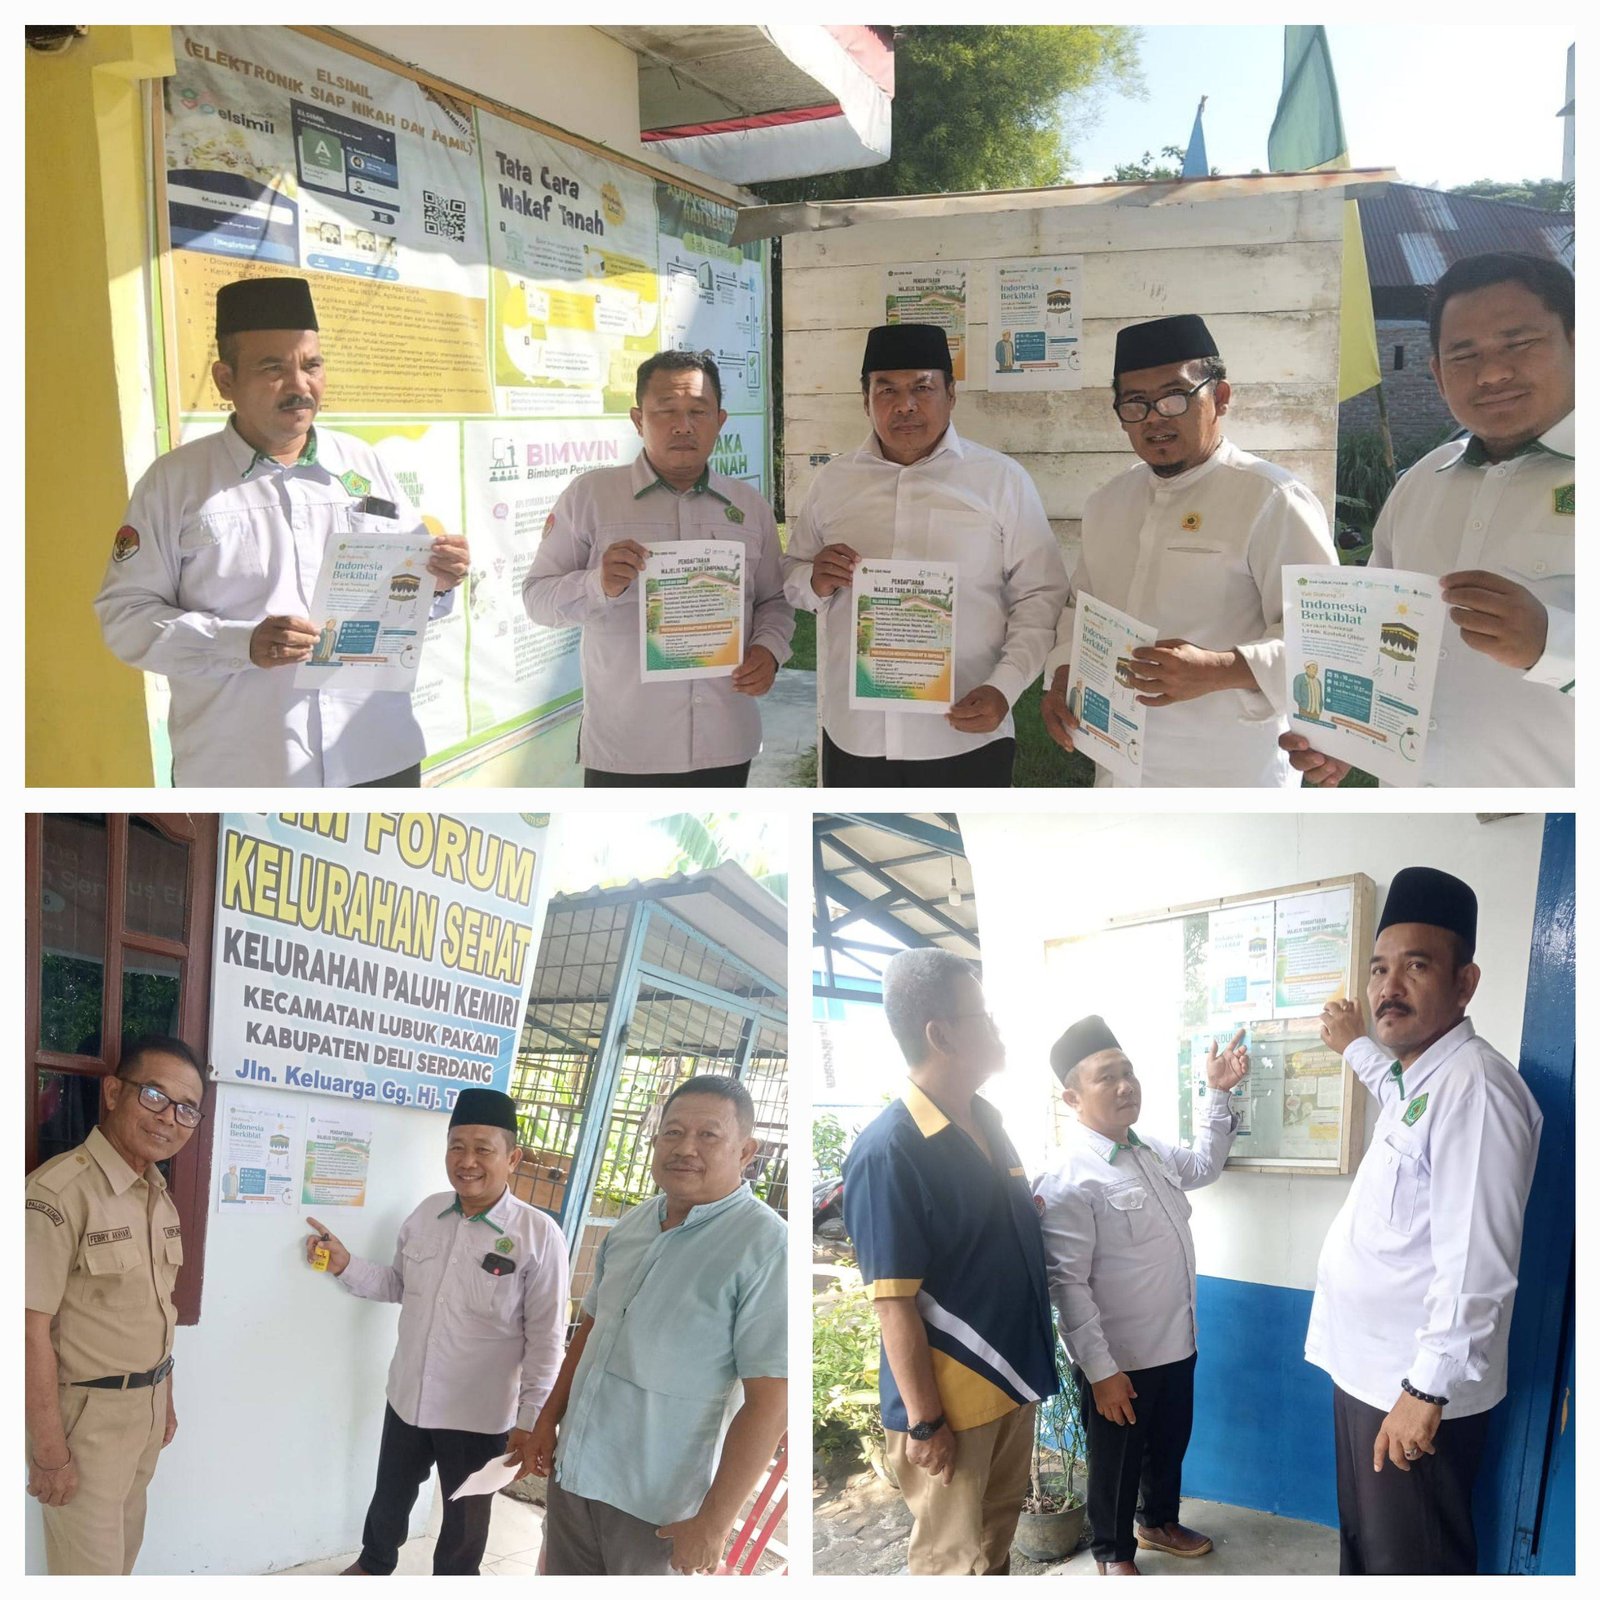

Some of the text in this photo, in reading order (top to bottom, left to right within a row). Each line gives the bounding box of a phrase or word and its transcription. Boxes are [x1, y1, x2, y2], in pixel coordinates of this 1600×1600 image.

[184, 37, 303, 94] (ELEKTRONIK
[310, 86, 345, 109] SIAP
[352, 101, 396, 127] NIKAH
[316, 68, 373, 100] ELSIMIL
[218, 108, 275, 135] elsimil
[315, 140, 333, 158] A
[496, 151, 579, 199] Tata Cara
[499, 184, 604, 236] Wakaf Tanah
[527, 440, 618, 467] BIMWIN
[527, 465, 568, 480] Bimbingan
[332, 570, 378, 582] Berkiblat
[334, 560, 384, 571] Indonesia
[1300, 599, 1368, 614] Indonesia
[1301, 610, 1362, 626] Berkiblat
[364, 813, 536, 907] FORUM
[222, 829, 533, 986] KELURAHAN SEHAT
[223, 926, 520, 1029] KELURAHAN PALUH KEMIRI
[243, 984, 499, 1056] KECAMATAN LUBUK PAKAM
[246, 1021, 493, 1084] KABUPATEN DELI SERDANG
[235, 1058, 277, 1083] Jln.
[285, 1064, 376, 1100] Keluarga
[382, 1079, 412, 1106] Gg.
[417, 1085, 440, 1110] Hj.
[230, 1121, 264, 1132] Indonesia
[230, 1129, 261, 1140] Berkiblat
[90, 1232, 109, 1243] FEBRY
